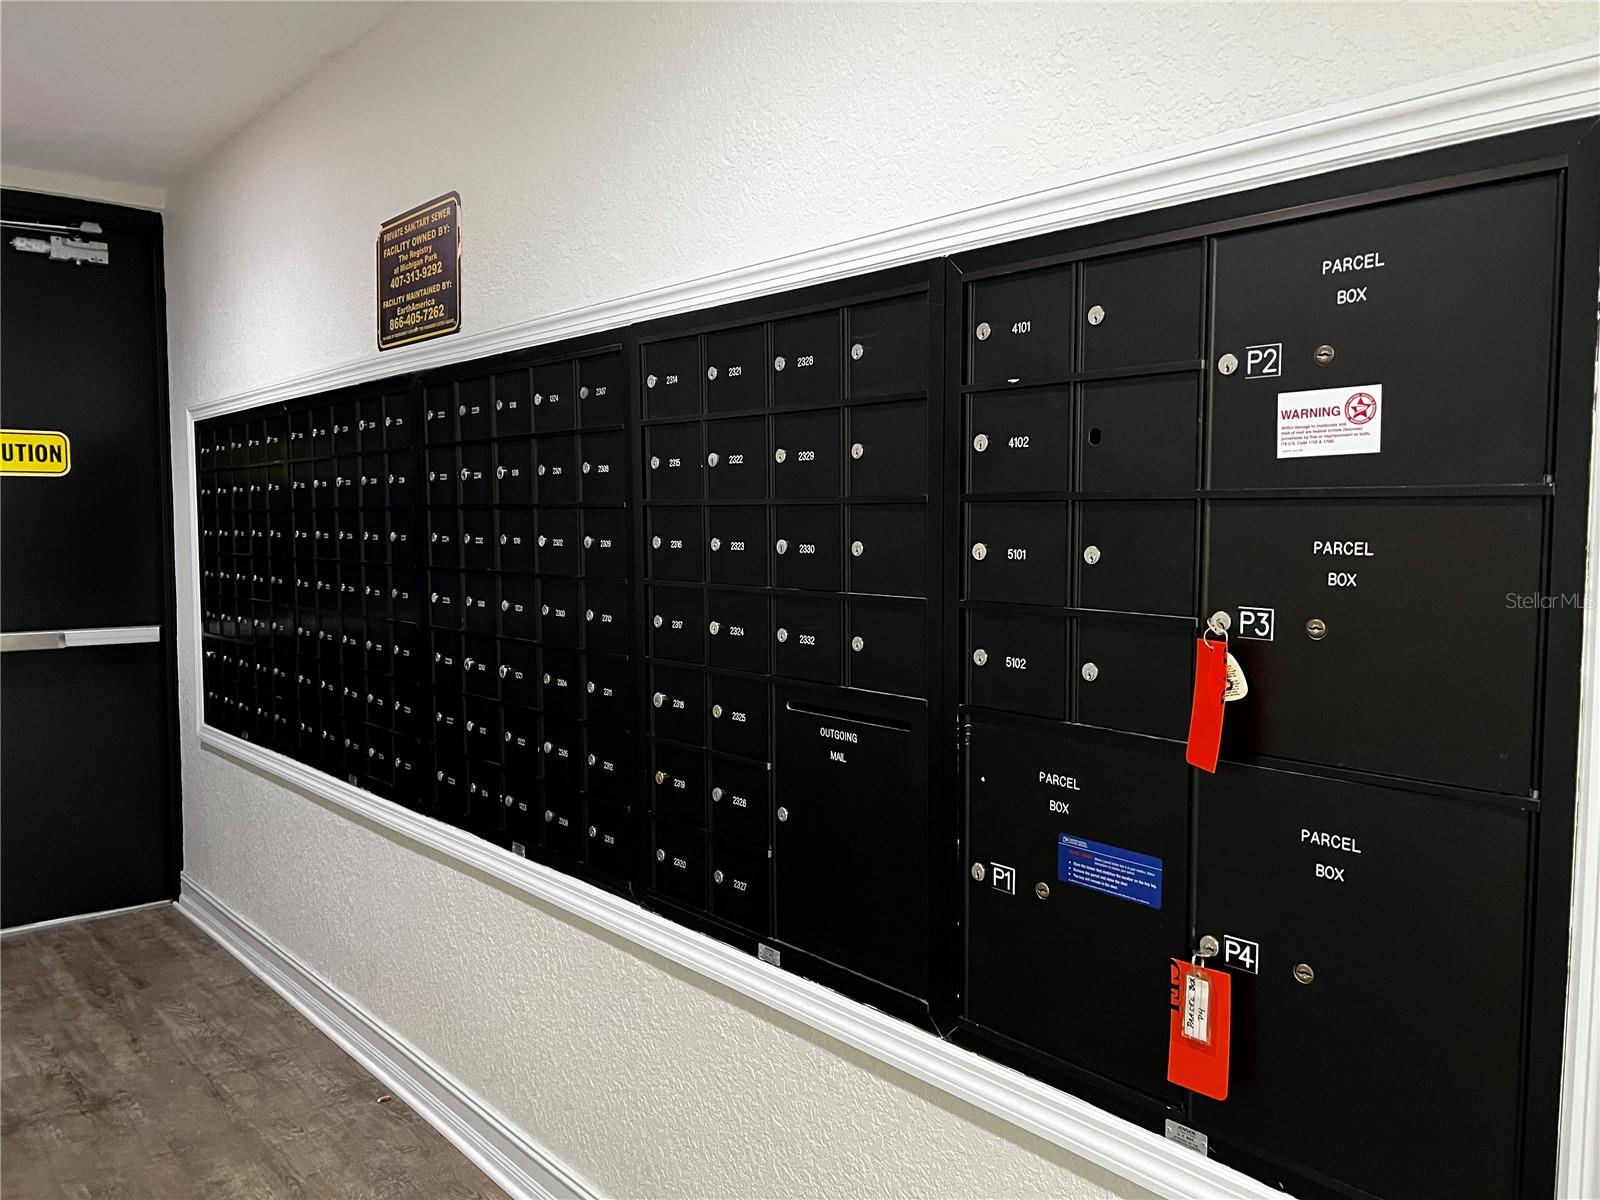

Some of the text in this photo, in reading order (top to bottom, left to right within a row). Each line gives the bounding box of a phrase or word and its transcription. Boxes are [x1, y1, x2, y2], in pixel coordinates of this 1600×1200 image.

[383, 207, 451, 243] PRIVATE SANITARY SEWER
[383, 224, 450, 258] FACILITY OWNED BY:
[398, 245, 432, 263] The Registry
[393, 252, 438, 275] at Michigan Park
[1323, 253, 1384, 274] PARCEL
[390, 261, 443, 289] 407-313-9292
[382, 280, 453, 309] FACILITY MAINTAINED BY:
[1337, 287, 1367, 304] BOX
[396, 298, 435, 316] EarthAmerica
[389, 304, 445, 331] 866-405-7262
[1012, 321, 1030, 334] 4101
[798, 356, 813, 367] 2328
[1247, 348, 1277, 375] P2
[729, 367, 741, 376] 2321
[667, 375, 677, 384] 2314
[1281, 406, 1341, 421] WARNING
[1009, 436, 1029, 448] 4102
[1, 443, 62, 463] UTION
[729, 455, 743, 464] 2322
[799, 451, 814, 461] 2329
[669, 459, 680, 467] 2315
[671, 540, 682, 548] 2316
[731, 542, 744, 550] 2323
[800, 544, 815, 553] 2330
[1314, 541, 1374, 556] PARCEL
[1008, 549, 1026, 560] 5101
[1328, 573, 1357, 586] BOX
[1239, 611, 1270, 637] P3
[730, 627, 744, 635] 2324
[800, 635, 815, 645] 2332
[1006, 657, 1026, 669] 5102
[673, 700, 684, 708] 2318
[732, 712, 746, 722] 2325
[820, 728, 857, 743] OUTGOING
[831, 751, 846, 762] MAIL
[674, 779, 685, 788] 2319
[1040, 772, 1080, 790] PARCEL
[733, 796, 746, 807] 2326
[1050, 800, 1069, 814] BOX
[1302, 829, 1361, 853] PARCEL
[674, 858, 686, 868] 2320
[1316, 864, 1344, 881] BOX
[734, 880, 747, 890] 2327
[993, 868, 1012, 891] P1
[1225, 940, 1254, 969] P4
[1198, 1007, 1206, 1021] P4
